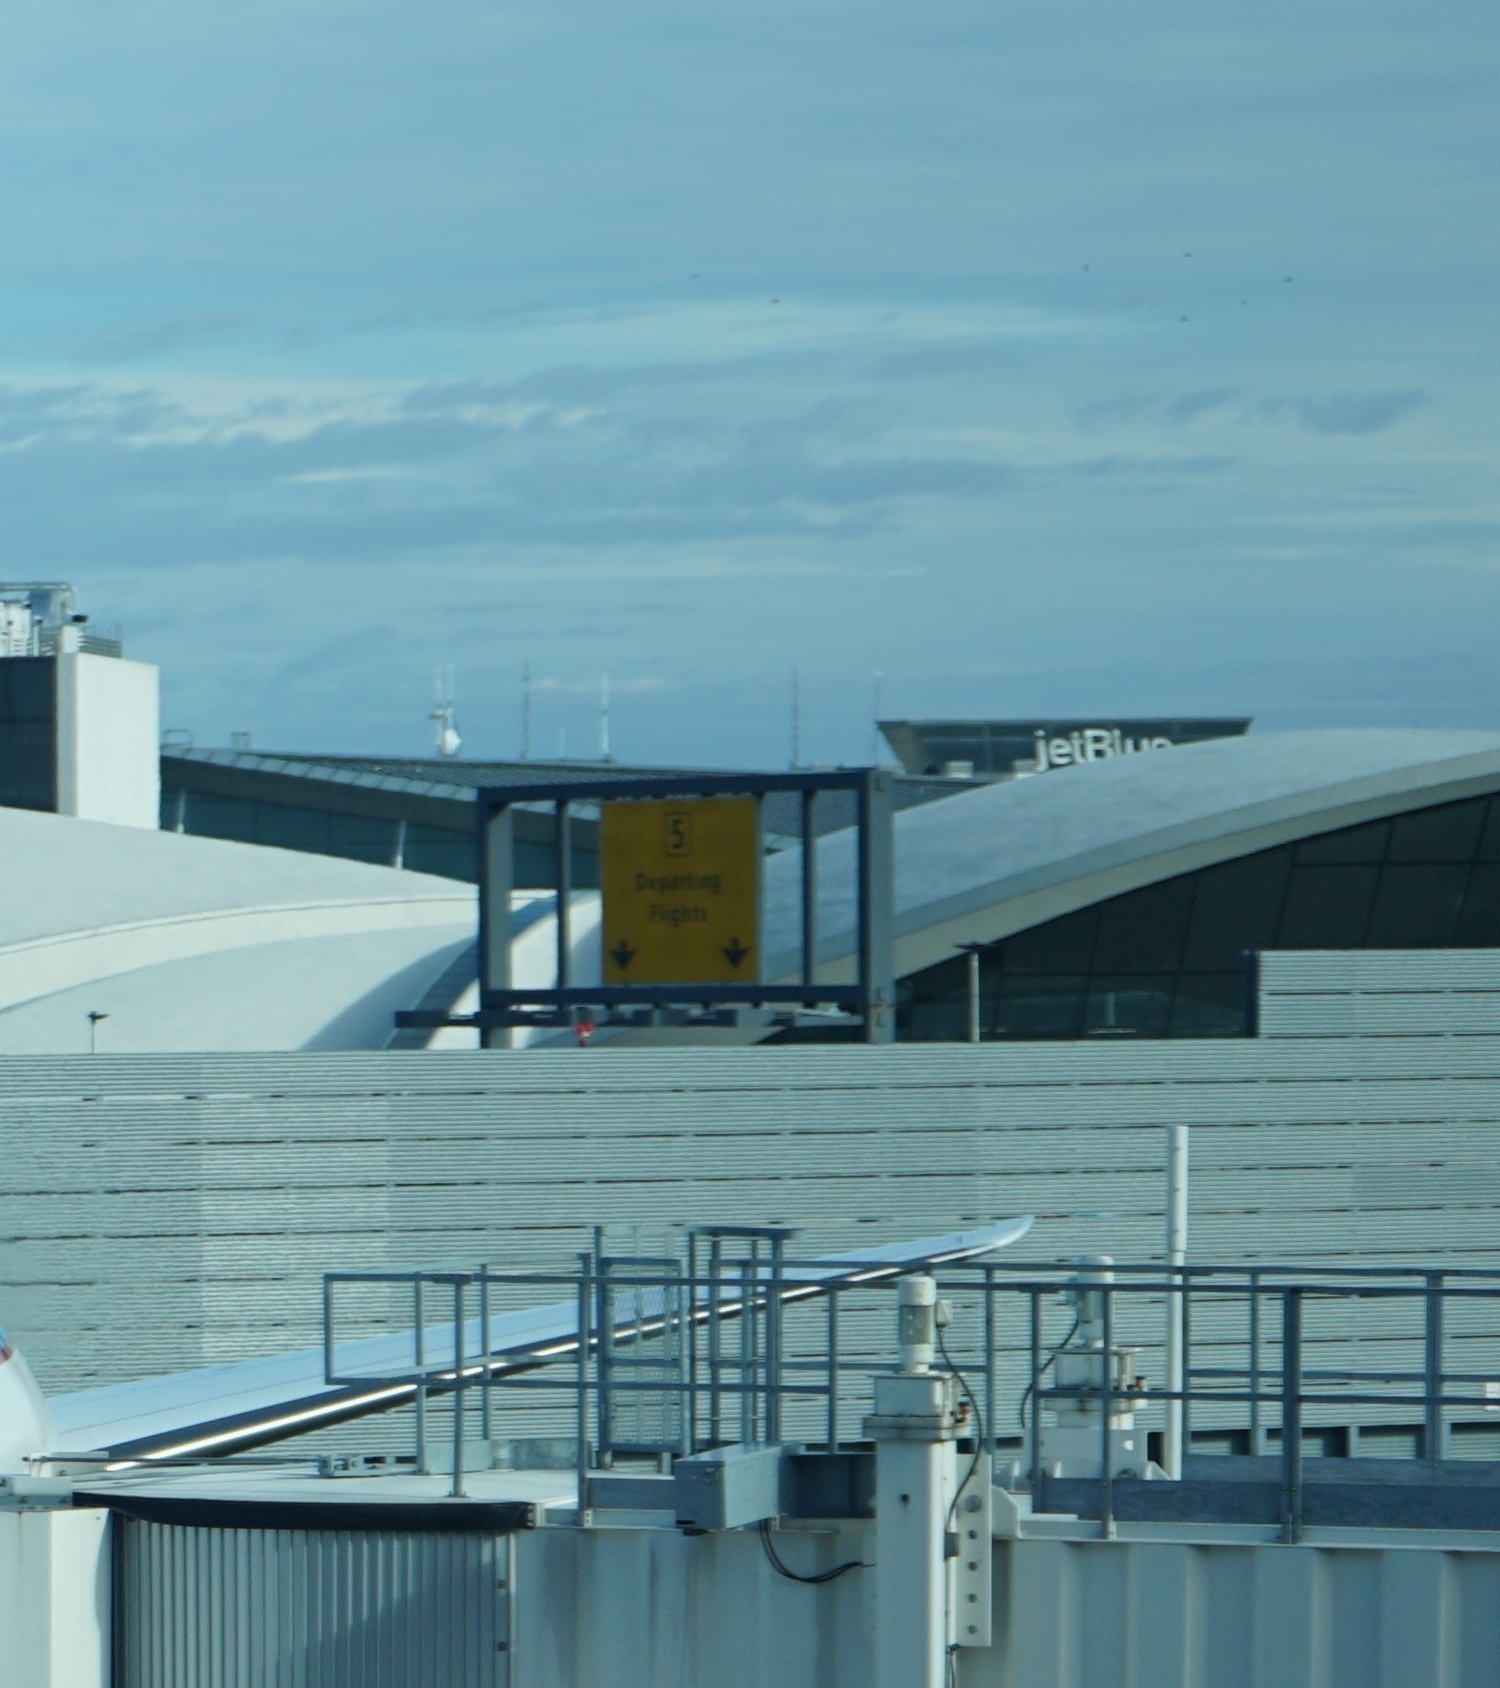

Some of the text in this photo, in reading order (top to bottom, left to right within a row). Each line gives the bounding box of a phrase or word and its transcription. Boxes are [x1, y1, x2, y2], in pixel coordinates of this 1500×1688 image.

[671, 819, 684, 849] 5
[635, 873, 722, 896] Departing
[649, 902, 708, 927] Flights
